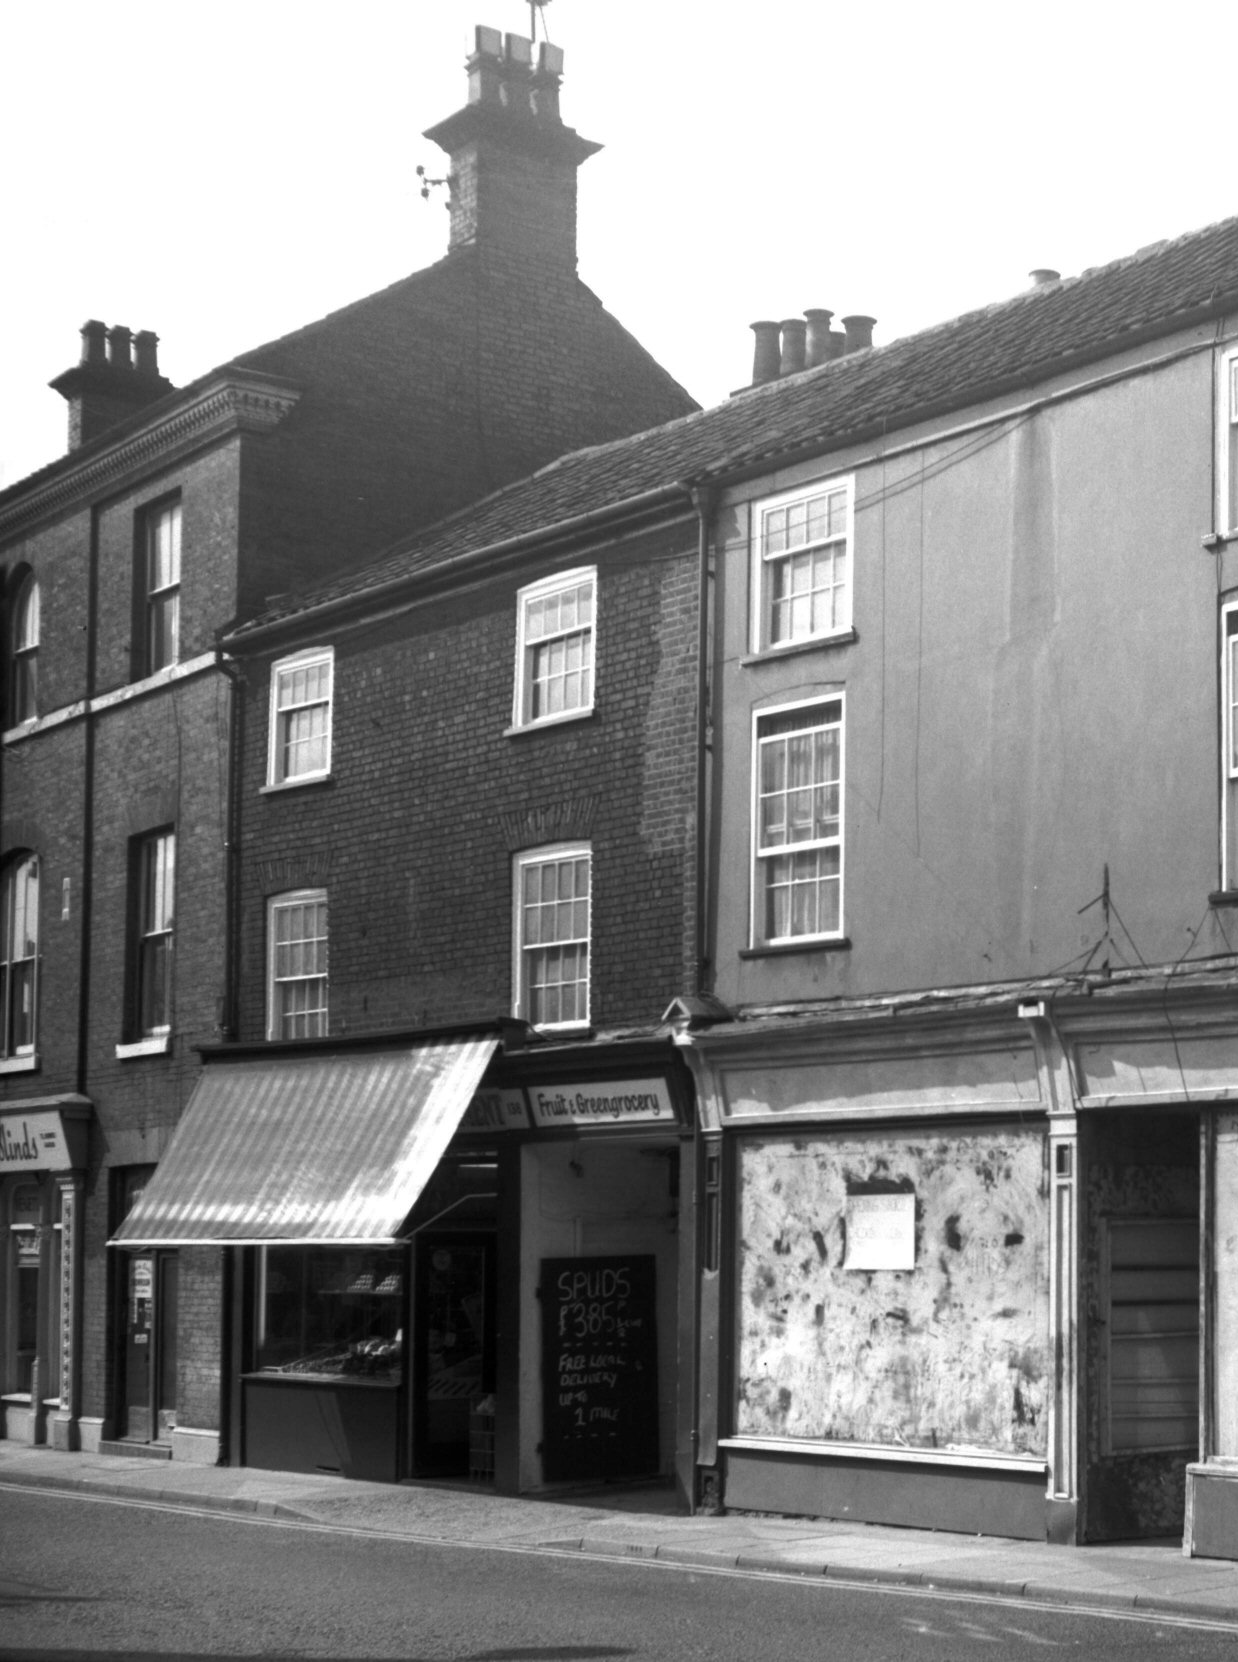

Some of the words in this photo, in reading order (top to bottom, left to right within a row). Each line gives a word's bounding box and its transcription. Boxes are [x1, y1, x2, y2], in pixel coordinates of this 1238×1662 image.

[537, 1092, 568, 1117] Fruit
[576, 1092, 660, 1118] Greengrocery
[0, 1121, 38, 1161] linds
[558, 1267, 631, 1301] SPUDS
[558, 1353, 585, 1371] FREE
[590, 1354, 626, 1367] LOCAL
[560, 1372, 617, 1388] DELIVERY
[559, 1392, 573, 1406] UP
[574, 1407, 587, 1427] 1
[590, 1406, 620, 1422] MILE
